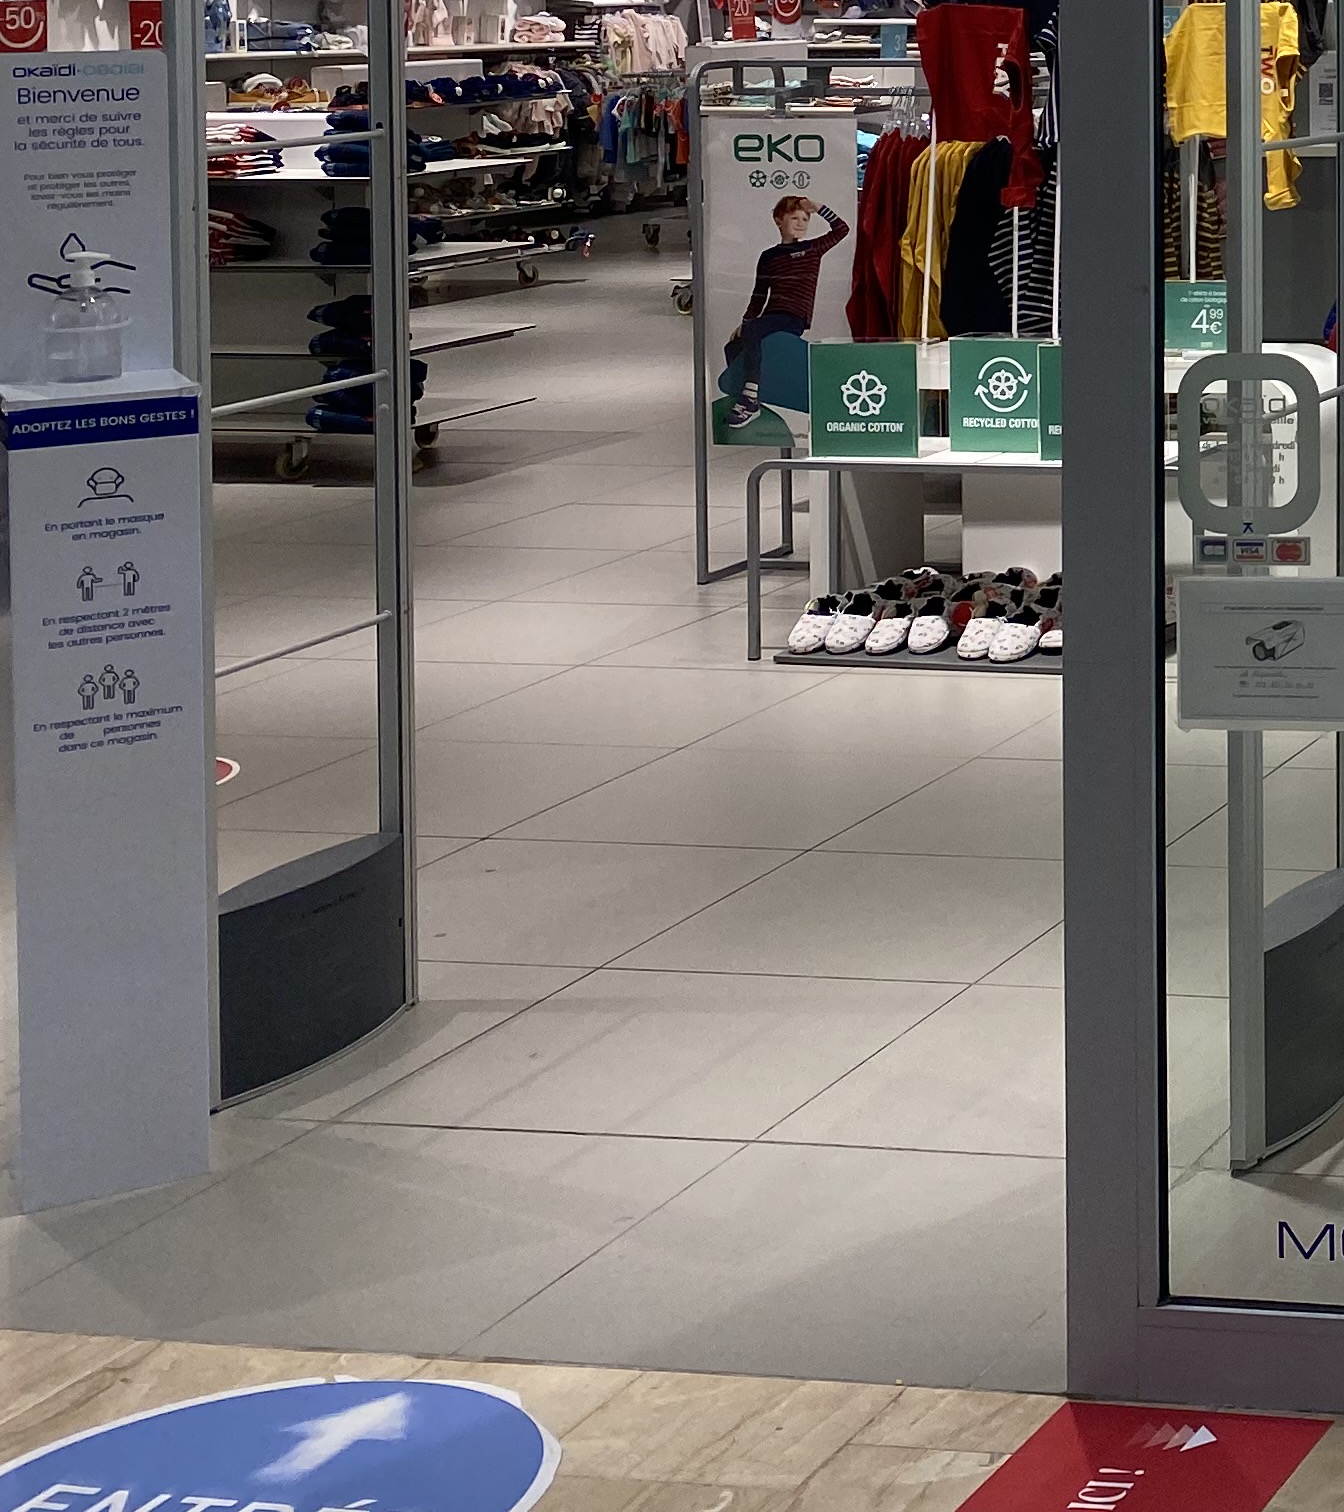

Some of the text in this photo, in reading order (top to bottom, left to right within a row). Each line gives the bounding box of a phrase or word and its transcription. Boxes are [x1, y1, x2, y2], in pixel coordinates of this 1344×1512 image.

[17, 86, 140, 105] Bienvenue
[17, 112, 141, 125] et merci de suivre
[28, 126, 48, 137] les
[99, 125, 130, 138] pour
[14, 140, 27, 151] la
[91, 137, 109, 148] de
[733, 133, 825, 163] eko
[12, 421, 72, 435] ADOPTEZ
[75, 418, 97, 429] LES
[100, 414, 136, 427] BONS
[139, 410, 187, 424] GESTES
[826, 422, 866, 432] ORGANIC
[962, 417, 1038, 428] RECYCLED COTTO
